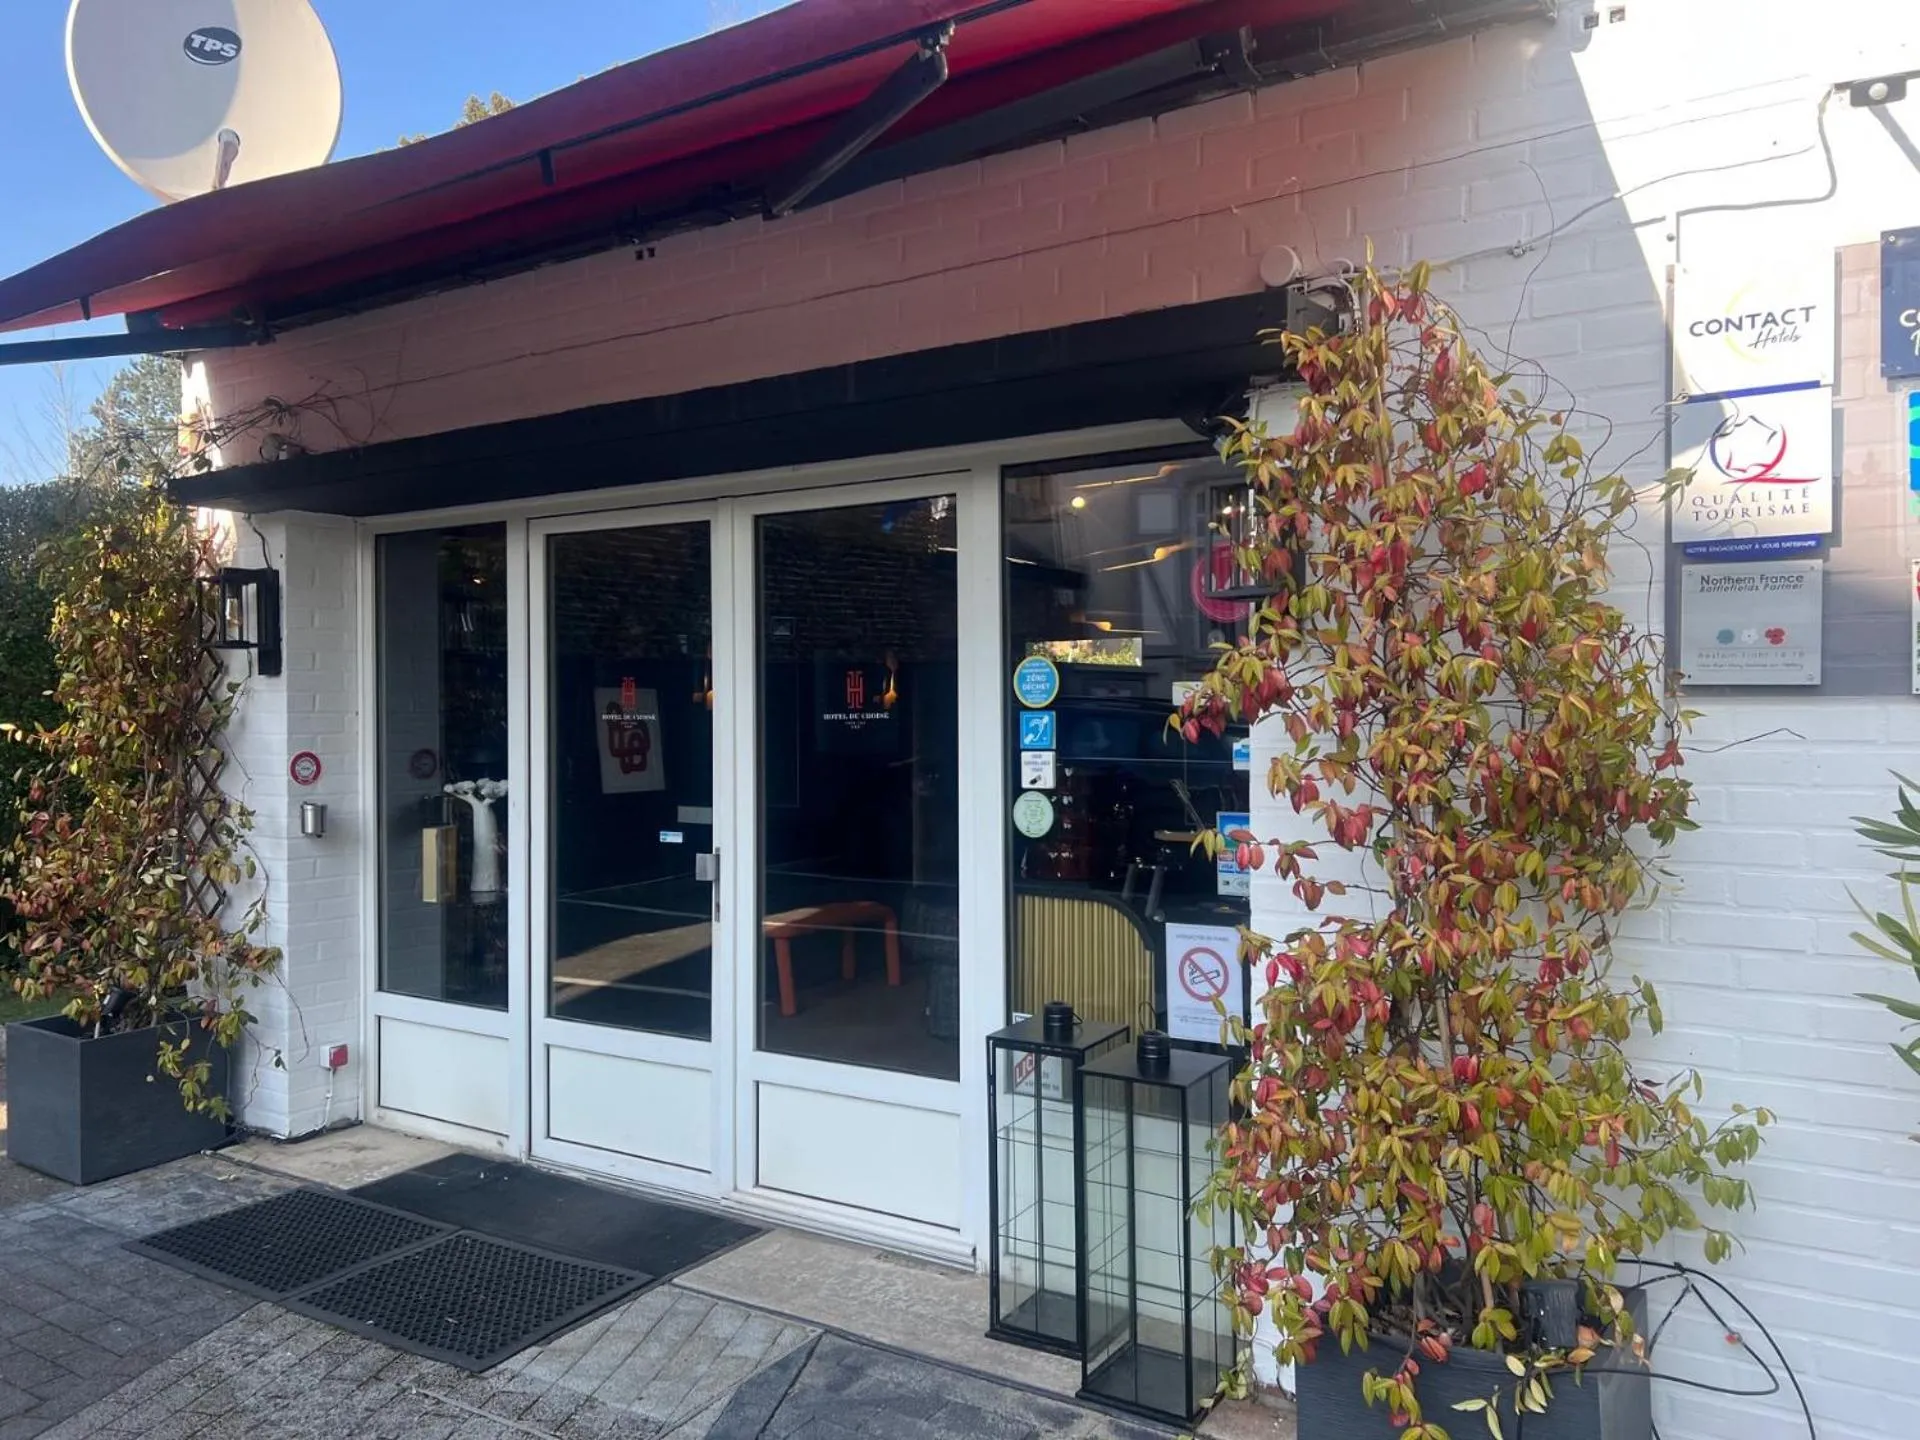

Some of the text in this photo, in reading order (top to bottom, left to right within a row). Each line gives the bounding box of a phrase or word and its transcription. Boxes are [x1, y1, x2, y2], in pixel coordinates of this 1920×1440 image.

[191, 34, 238, 57] TPS
[1689, 305, 1817, 337] CONTACT
[1747, 325, 1802, 349] Hotels
[1692, 502, 1810, 522] TOURISME
[1699, 582, 1805, 593] Battlefields Partner
[1700, 573, 1805, 586] Northern France
